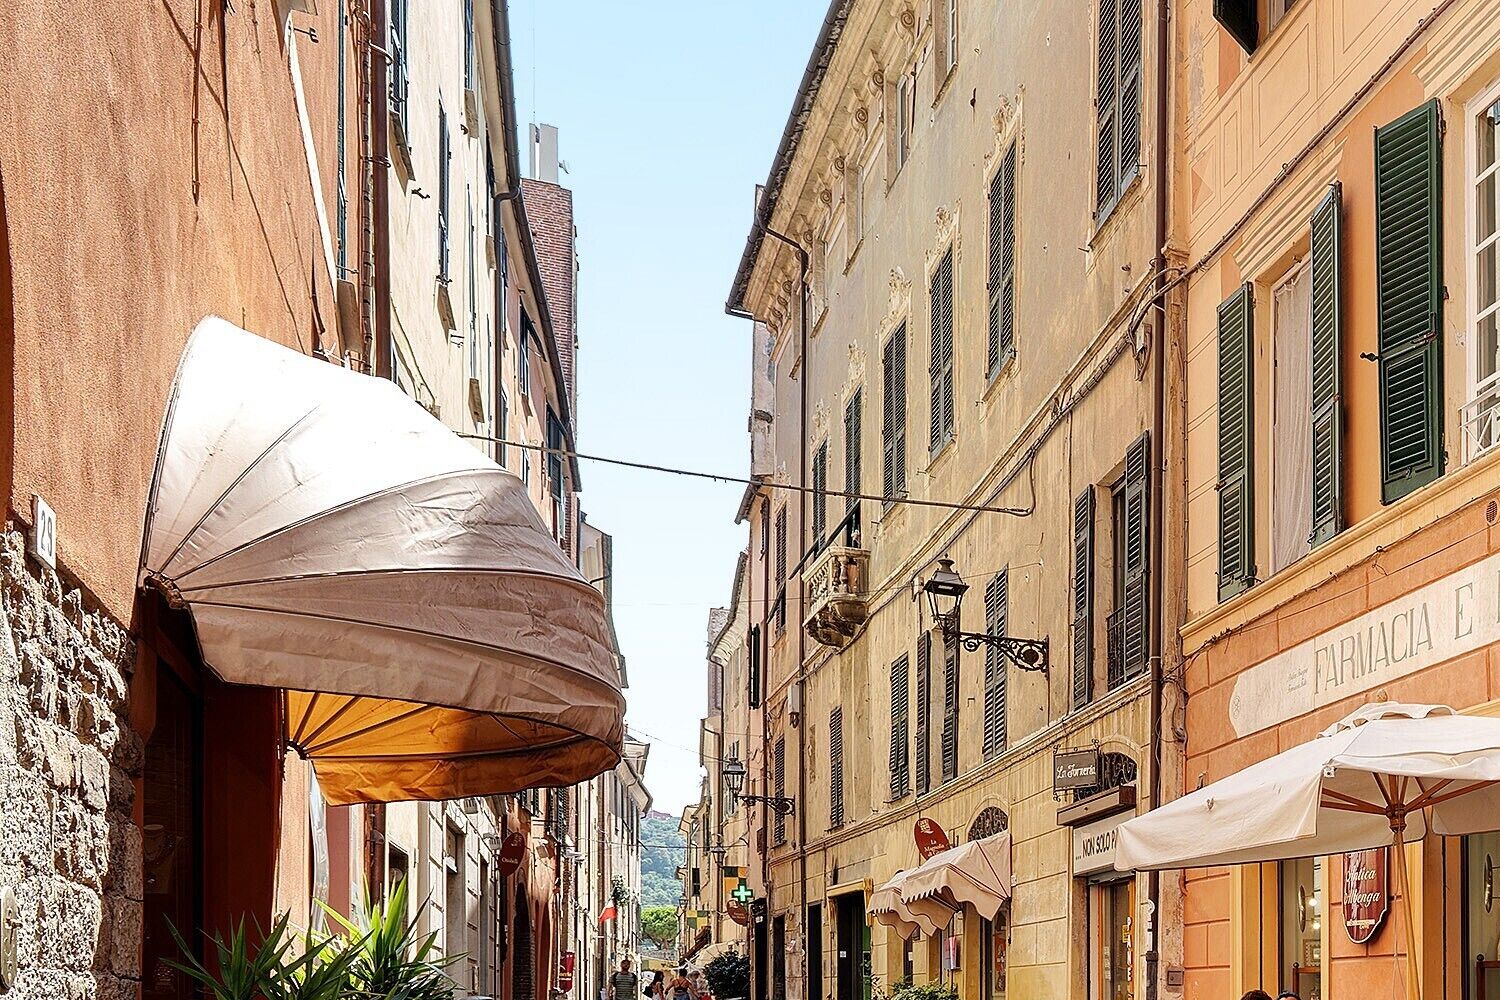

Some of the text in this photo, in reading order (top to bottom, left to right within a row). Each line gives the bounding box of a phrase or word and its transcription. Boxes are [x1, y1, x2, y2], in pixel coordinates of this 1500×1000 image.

[41, 510, 53, 557] 29
[1315, 602, 1433, 694] FARMACIA
[1454, 582, 1474, 640] E
[1082, 836, 1095, 858] NON
[1096, 831, 1110, 855] SOLO
